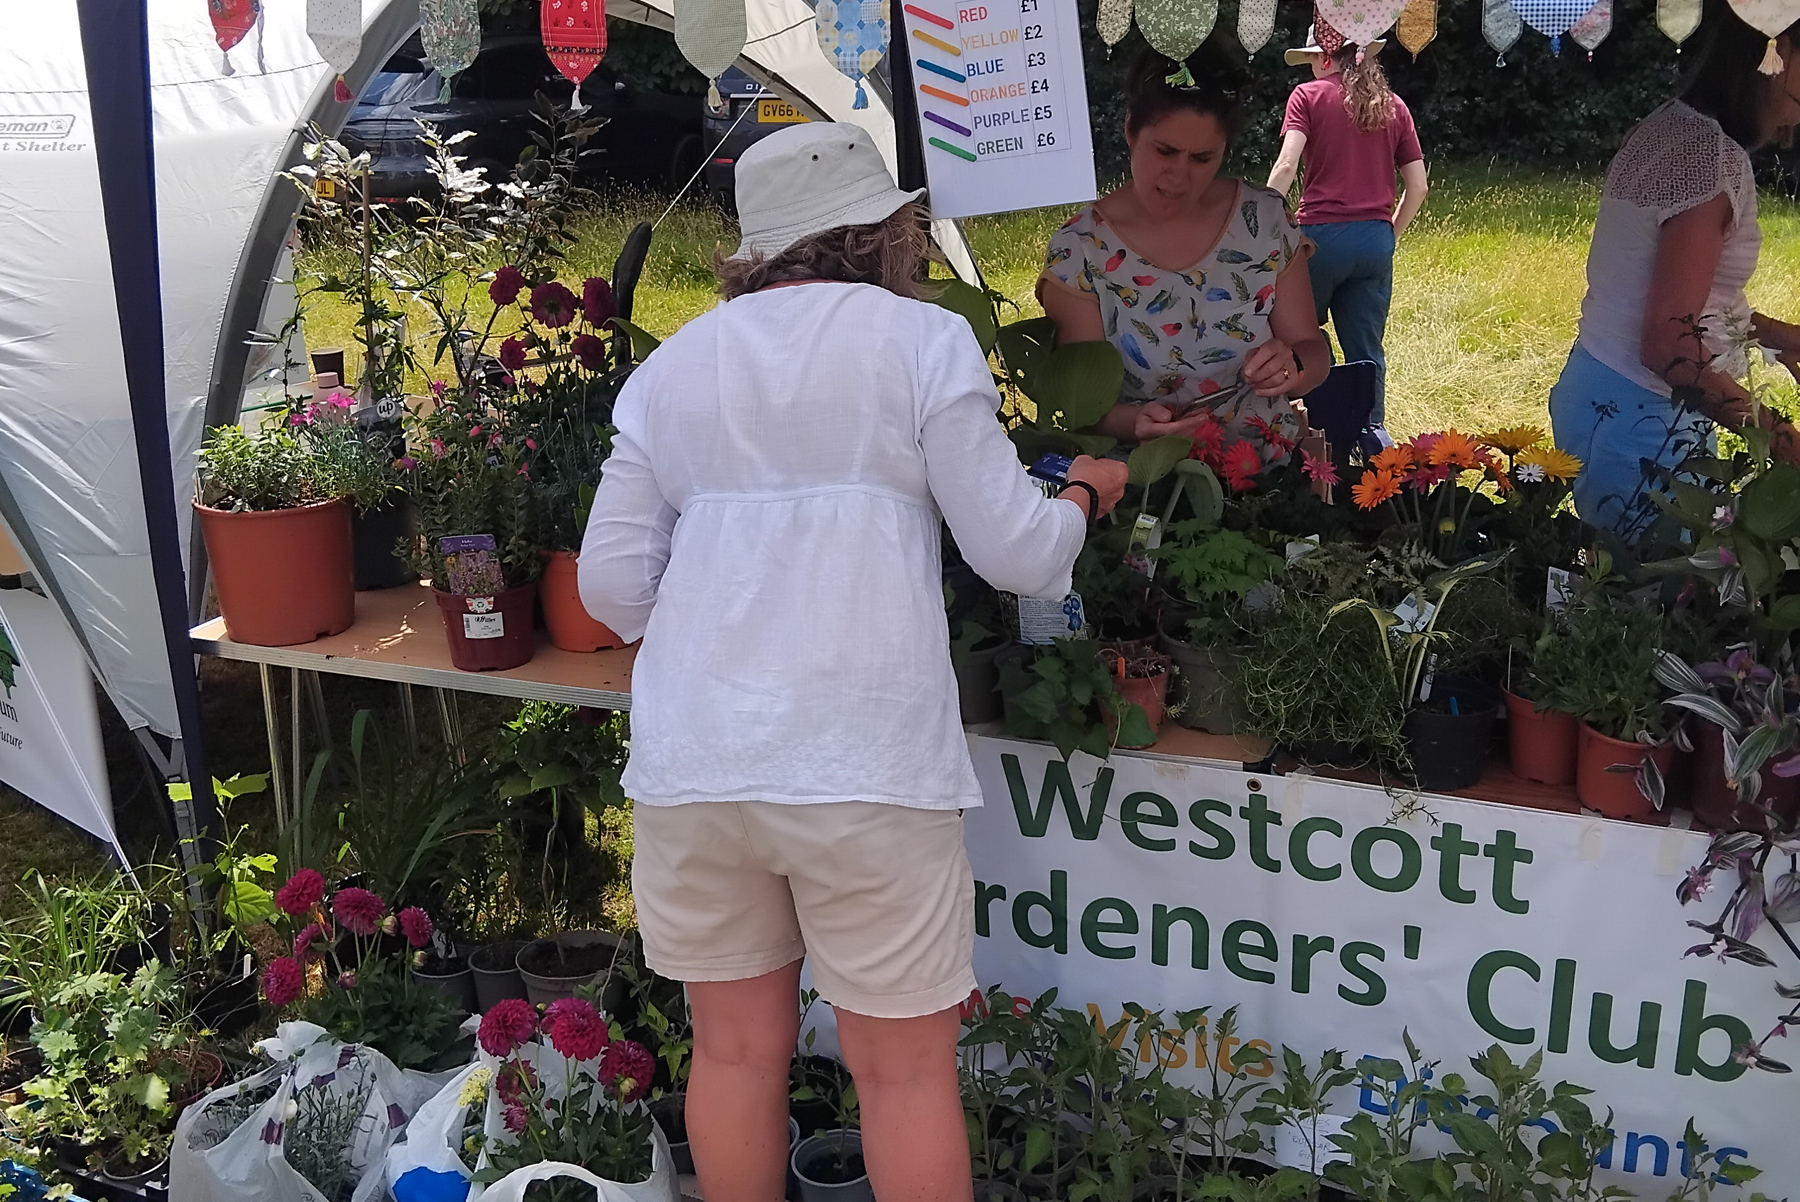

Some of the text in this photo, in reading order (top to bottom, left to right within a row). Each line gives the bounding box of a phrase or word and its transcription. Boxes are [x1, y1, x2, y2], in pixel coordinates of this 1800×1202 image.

[959, 6, 988, 23] RED
[961, 24, 1043, 50] YELLOW £2
[966, 51, 1046, 77] BLUE £3
[970, 78, 1050, 103] ORANGE £4
[973, 105, 1053, 130] PURPLE £5
[15, 141, 87, 152] Shelter
[976, 132, 1056, 156] GREEN £6
[1000, 753, 1534, 915] Westcott
[1466, 950, 1754, 1083] Club
[1086, 1002, 1275, 1078] Visits
